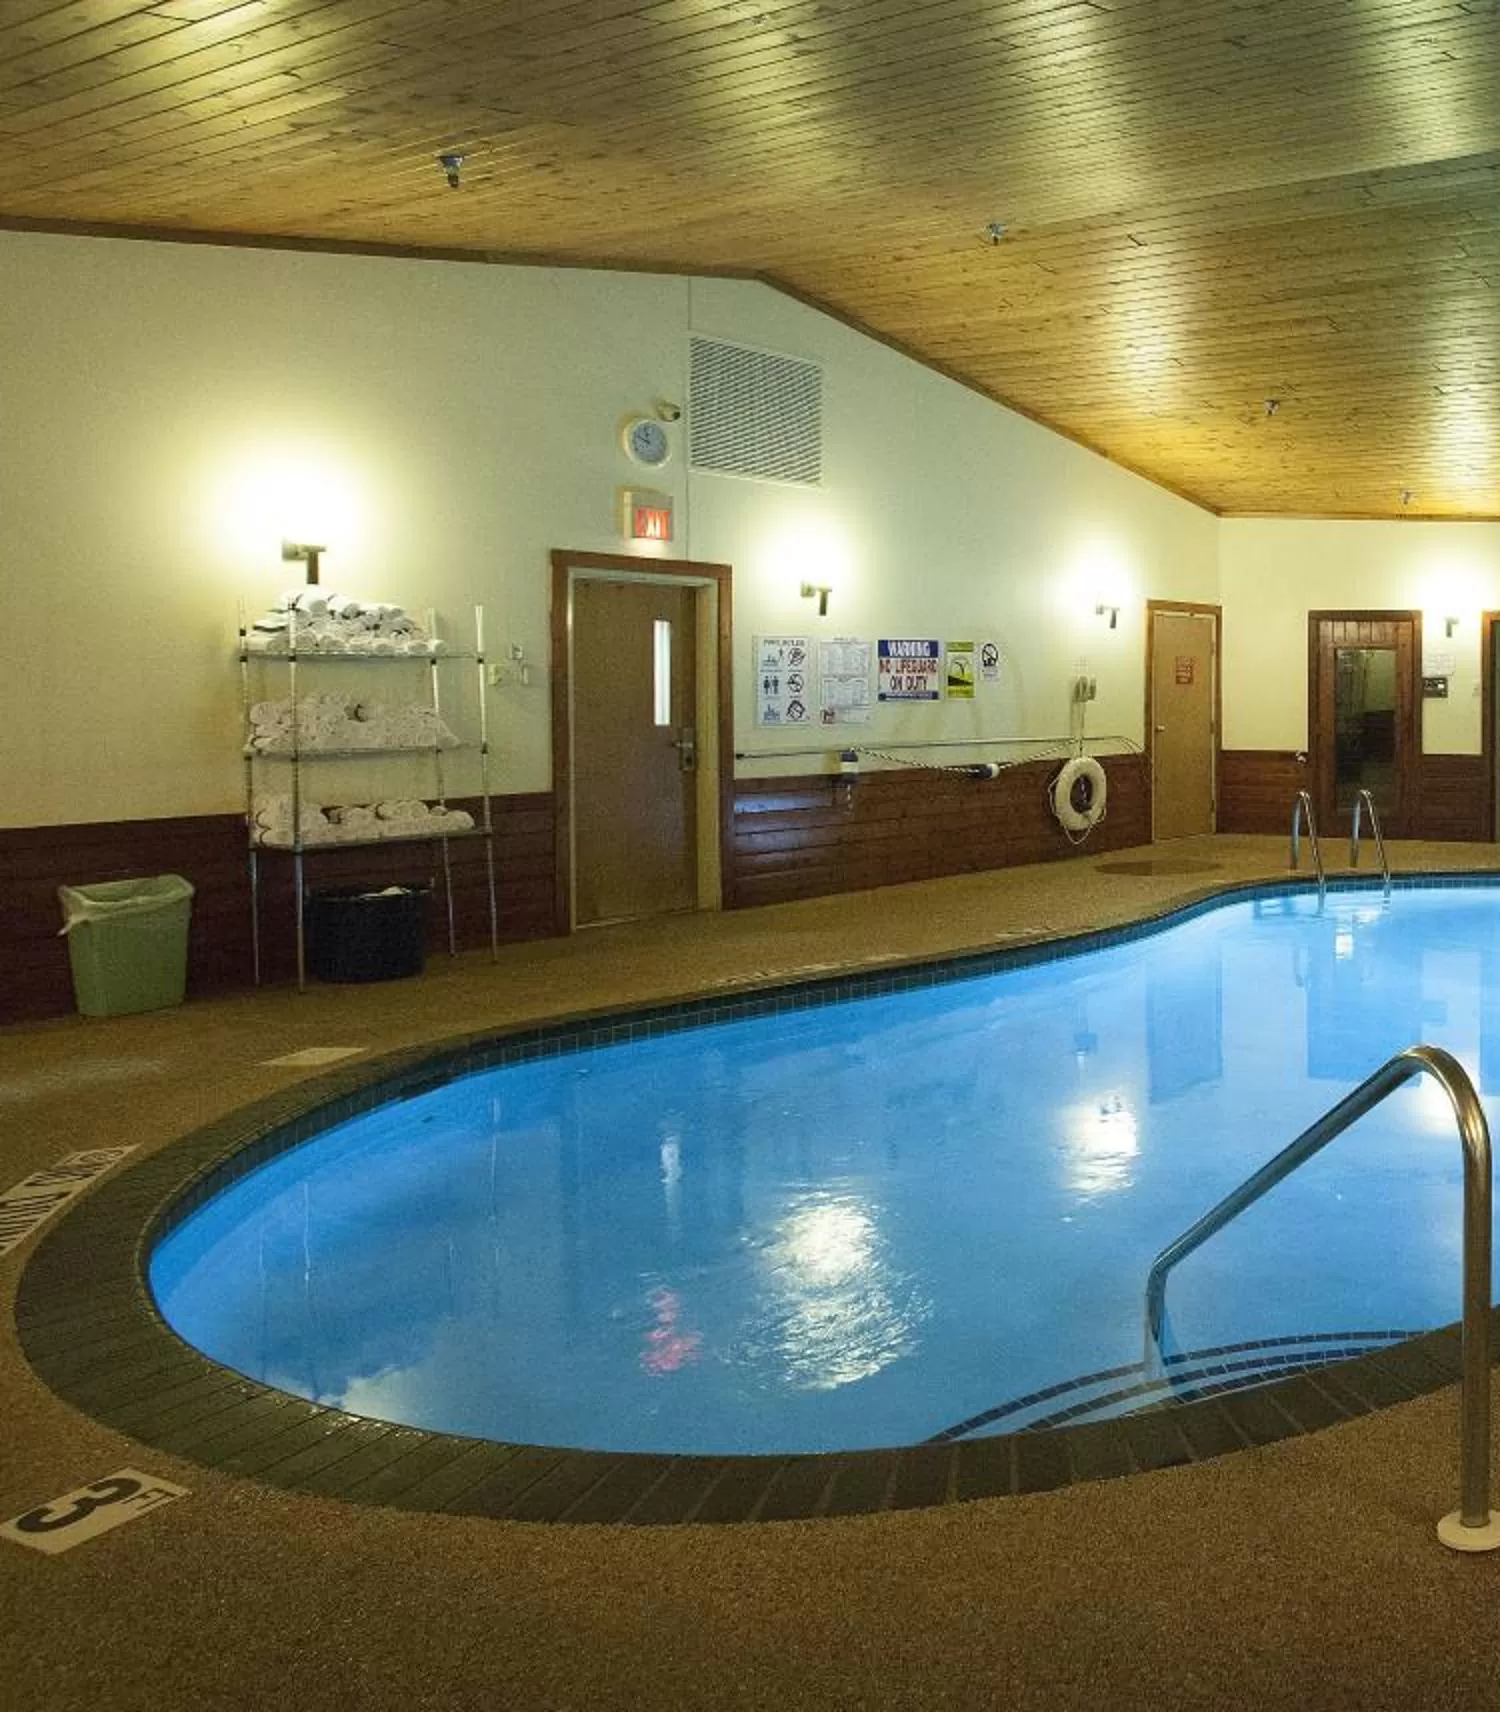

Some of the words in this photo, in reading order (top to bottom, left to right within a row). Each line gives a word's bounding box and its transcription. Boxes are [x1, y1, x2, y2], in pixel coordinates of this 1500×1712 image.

[888, 641, 930, 657] WARNING
[879, 659, 890, 673] NO
[895, 659, 937, 673] LIFEGUARD
[890, 675, 903, 690] ON
[906, 675, 929, 690] DUTY
[16, 1477, 142, 1533] 3
